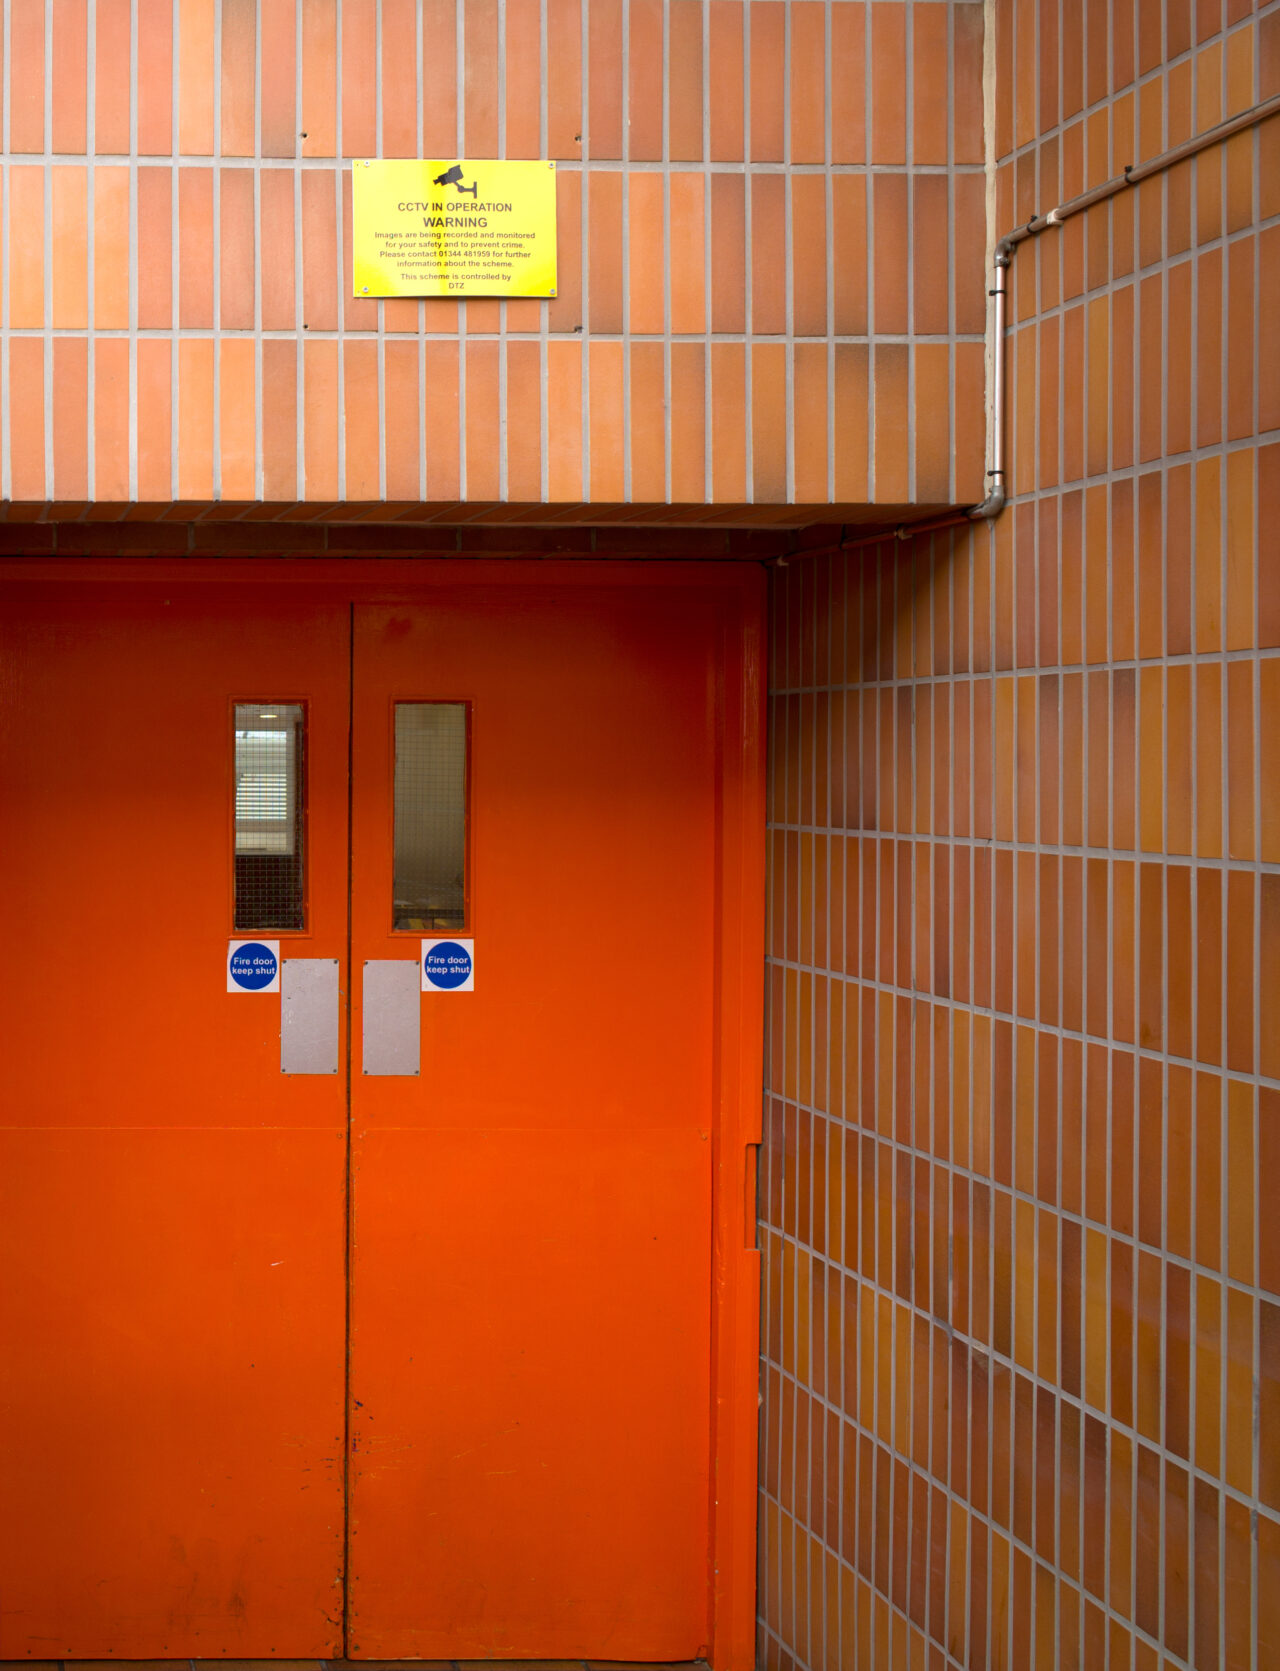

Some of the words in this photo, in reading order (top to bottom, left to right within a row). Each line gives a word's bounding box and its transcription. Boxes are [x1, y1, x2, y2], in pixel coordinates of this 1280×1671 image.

[398, 202, 428, 212] CCTV
[432, 202, 443, 212] IN
[446, 202, 513, 212] OPERATION
[423, 217, 488, 228] WARNING
[419, 241, 442, 249] safety
[502, 274, 511, 282] by
[233, 957, 251, 965] Fire
[253, 957, 273, 965] door
[428, 955, 445, 964] Fire
[447, 956, 468, 964] door
[232, 966, 253, 976] keep
[255, 966, 275, 975] shut
[426, 965, 448, 975] keep
[450, 965, 470, 974] shut
